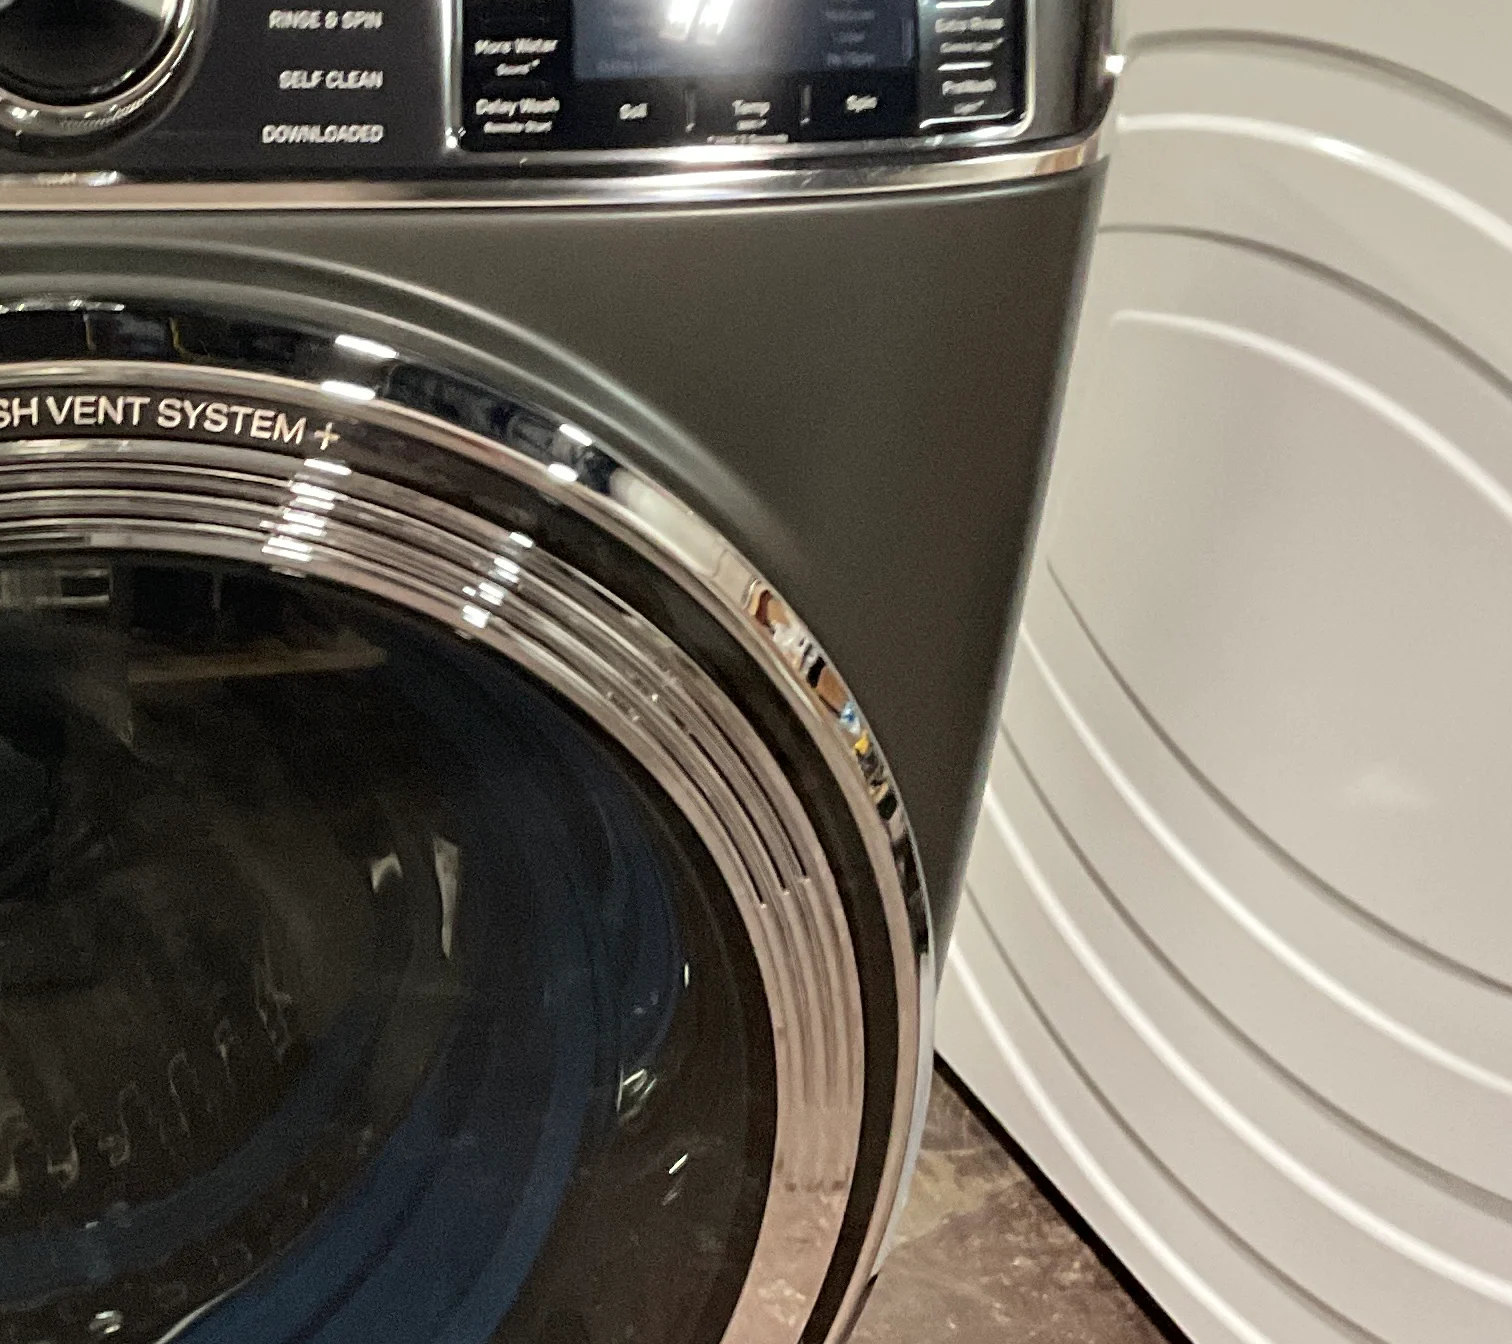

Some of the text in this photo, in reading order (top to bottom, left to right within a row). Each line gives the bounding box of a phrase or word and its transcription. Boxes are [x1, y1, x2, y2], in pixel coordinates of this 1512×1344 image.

[269, 10, 384, 30] RINSE & SPIN
[279, 69, 384, 90] SELF CLEAN
[262, 125, 384, 144] DOWNLOADED
[46, 394, 152, 427] VENT
[155, 398, 308, 446] SYSTEM
[313, 421, 342, 451] +
